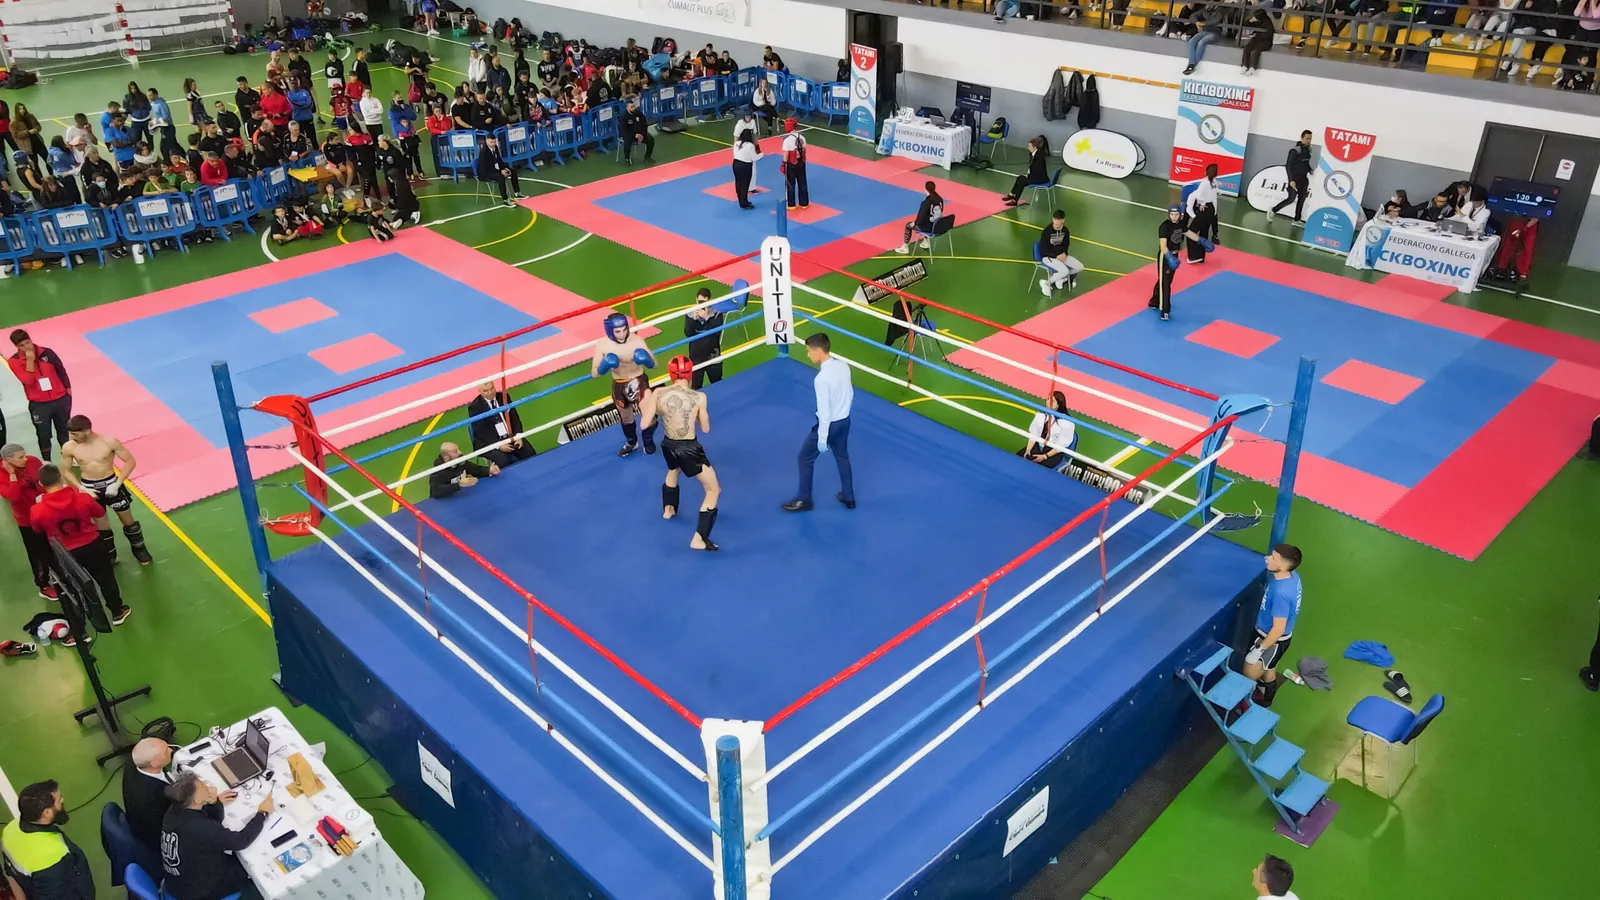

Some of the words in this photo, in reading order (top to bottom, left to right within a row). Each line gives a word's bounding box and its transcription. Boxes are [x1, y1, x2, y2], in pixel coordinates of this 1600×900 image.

[854, 46, 875, 57] TATAMI
[860, 57, 867, 69] 2
[1183, 81, 1251, 102] KICKBOXING
[1223, 99, 1249, 108] GALEGA
[925, 133, 946, 142] GALLEGA
[1330, 130, 1371, 146] TATAMI
[1342, 143, 1351, 159] 1
[1260, 178, 1279, 191] La
[1438, 246, 1476, 260] GALLEGA
[769, 246, 788, 344] UNITION
